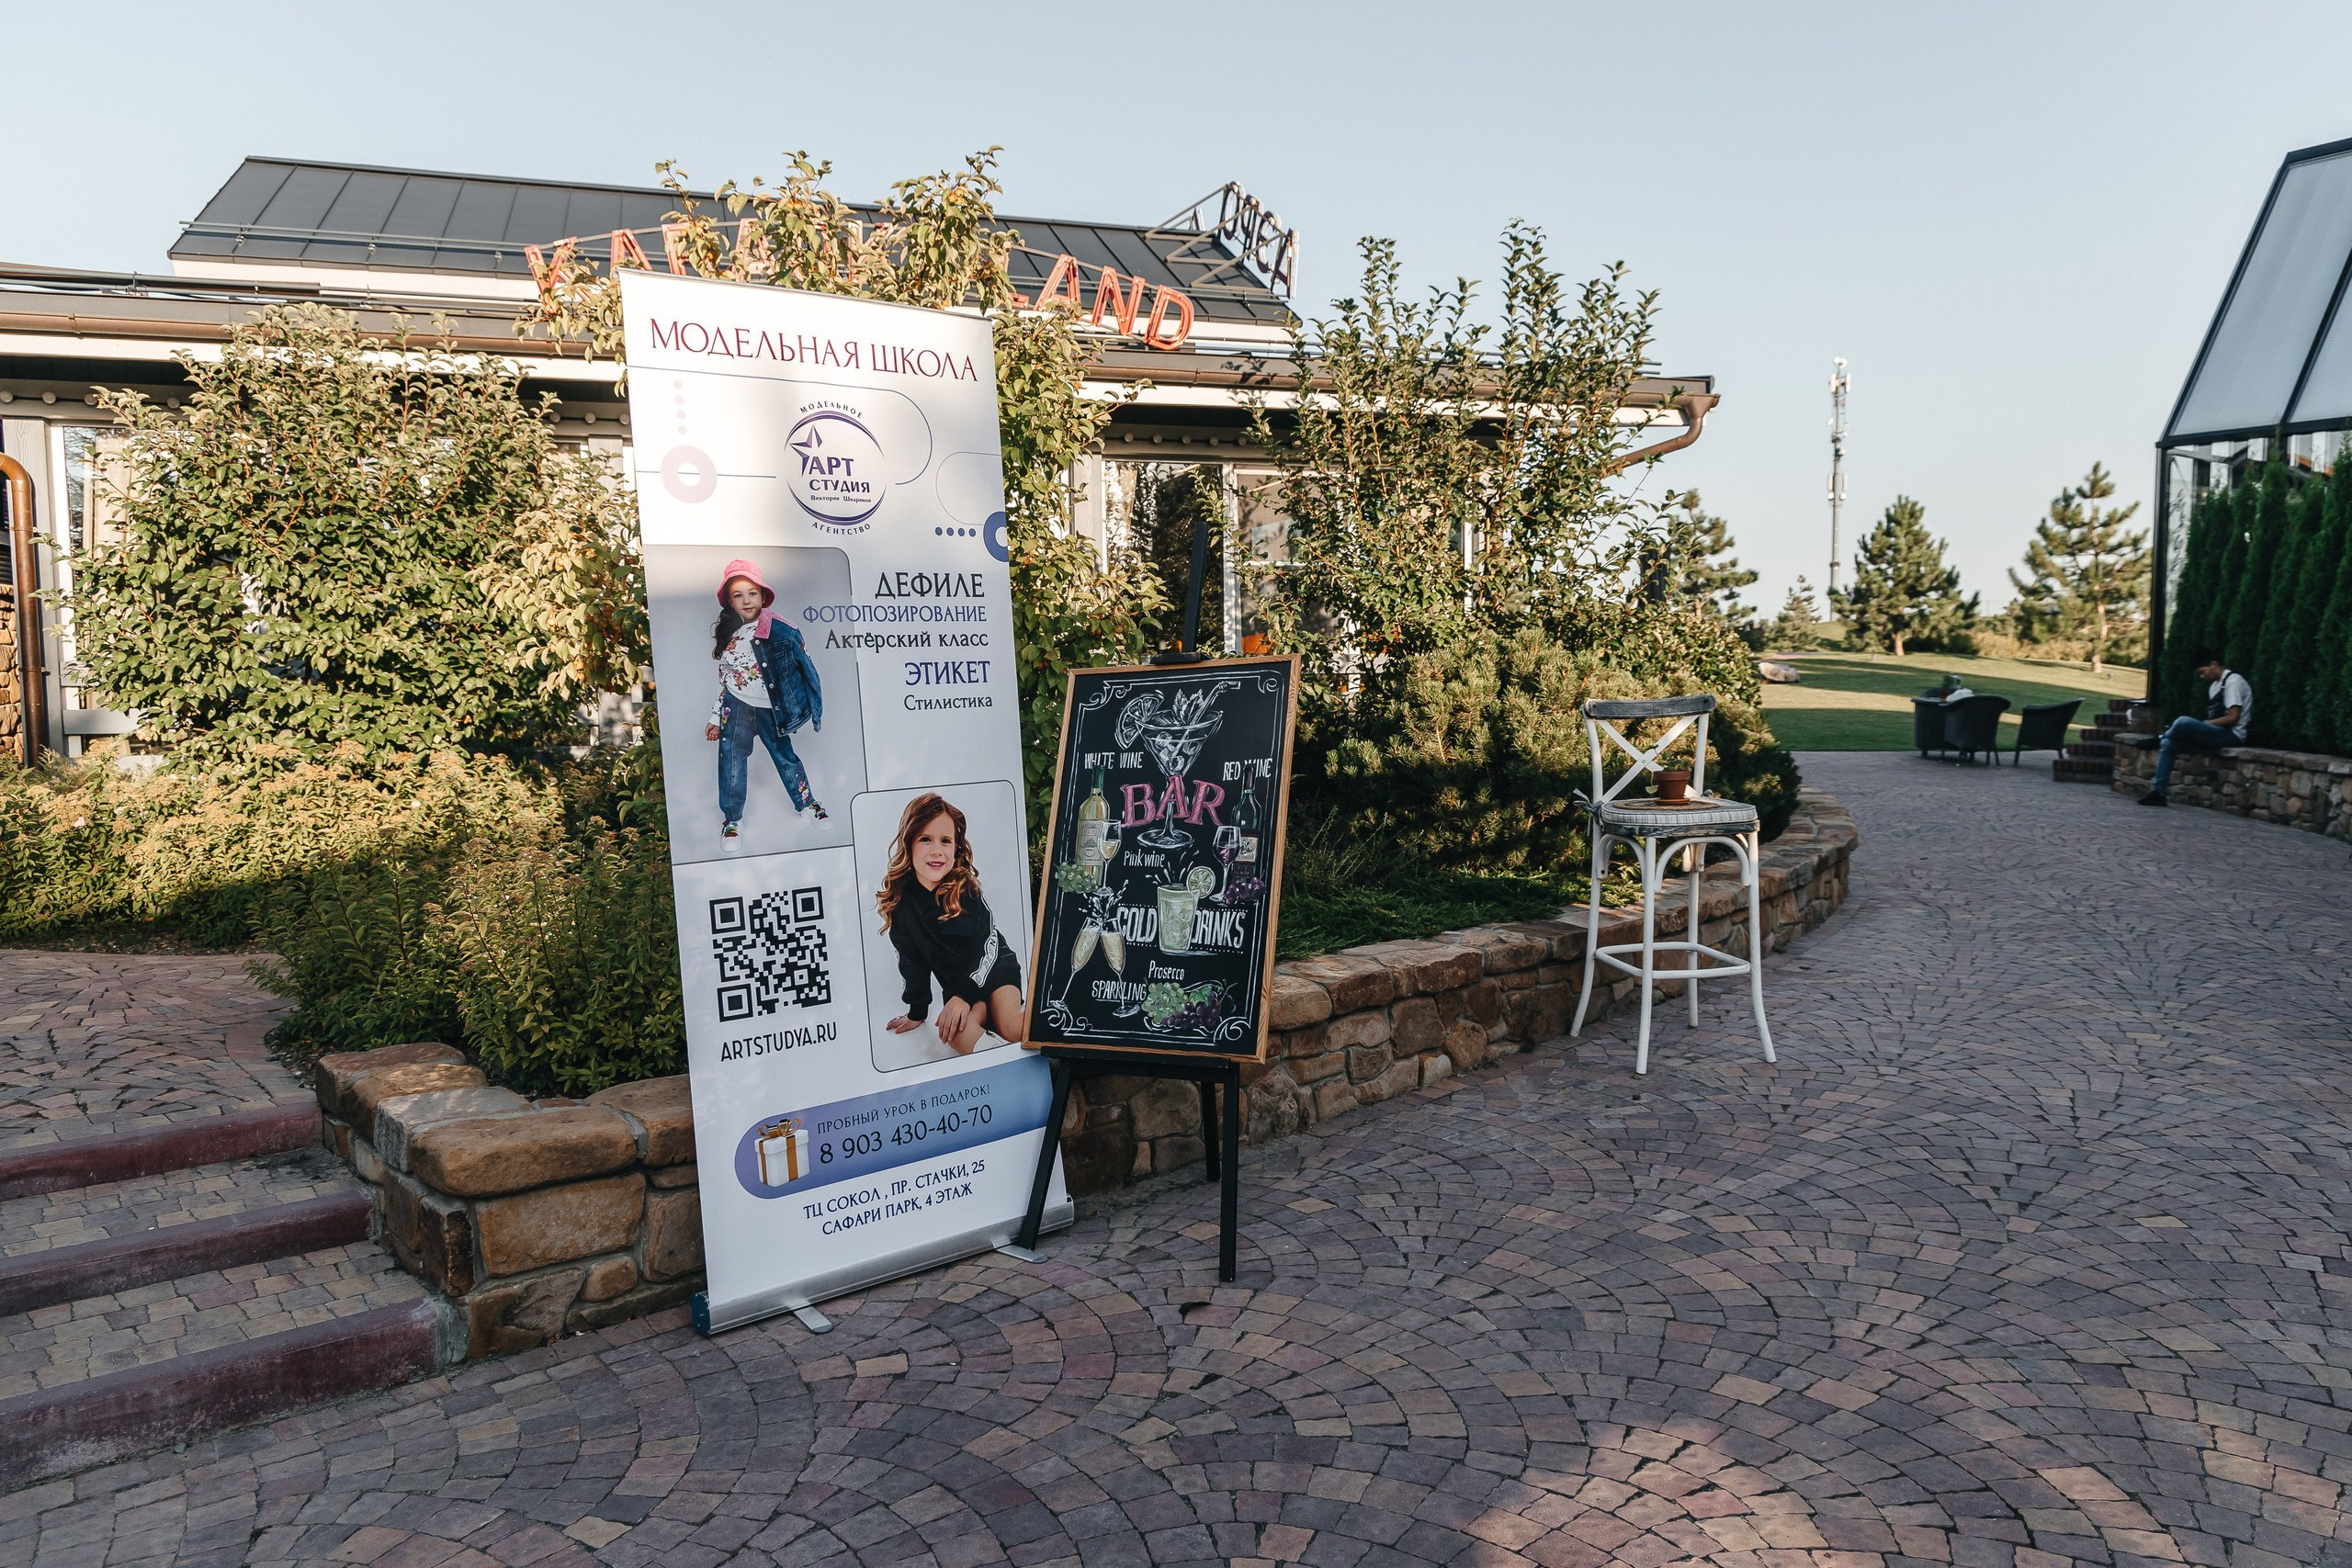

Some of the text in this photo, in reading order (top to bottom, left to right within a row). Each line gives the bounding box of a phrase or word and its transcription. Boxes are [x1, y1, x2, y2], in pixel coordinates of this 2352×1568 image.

[650, 317, 979, 382] МОДЕЛЬНАЯ ШКОЛА
[799, 400, 863, 419] МОДЕЛЬНОЕ
[808, 456, 854, 477] АРТ
[808, 479, 871, 493] СТУДИЯ
[810, 494, 841, 502] Виктории
[812, 522, 871, 536] АГЕНТСТВО
[875, 571, 985, 600] ДЕФИЛЕ
[802, 604, 988, 624] ФОТОПОЗИРОВАНИЕ
[825, 628, 989, 653] Актёрский класс
[904, 660, 990, 686] ЭТИКЕТ
[903, 694, 993, 711] Стилистика
[1084, 750, 1145, 770] WHITE WINE
[1223, 761, 1241, 781] RED
[1119, 773, 1227, 828] BAR
[1123, 850, 1166, 868] Pink wine
[1115, 906, 1247, 949] COLD DRINKS
[1148, 960, 1186, 981] Prosecco
[1091, 979, 1148, 1002] SPARKLING
[720, 1021, 837, 1062] ARTSTUDYA.RU
[817, 1083, 990, 1134] ПРОБНЫЙ УРОК В ПОДАРОК!
[820, 1104, 993, 1164] 8 903 430-40-70
[803, 1204, 824, 1219] ТЦ
[891, 1180, 911, 1197] ПР.
[914, 1164, 969, 1189] СТАЧКИ,
[971, 1159, 986, 1174] 25
[821, 1182, 974, 1235] САФАРИ ПАРК, 4 ЭТАЖ
